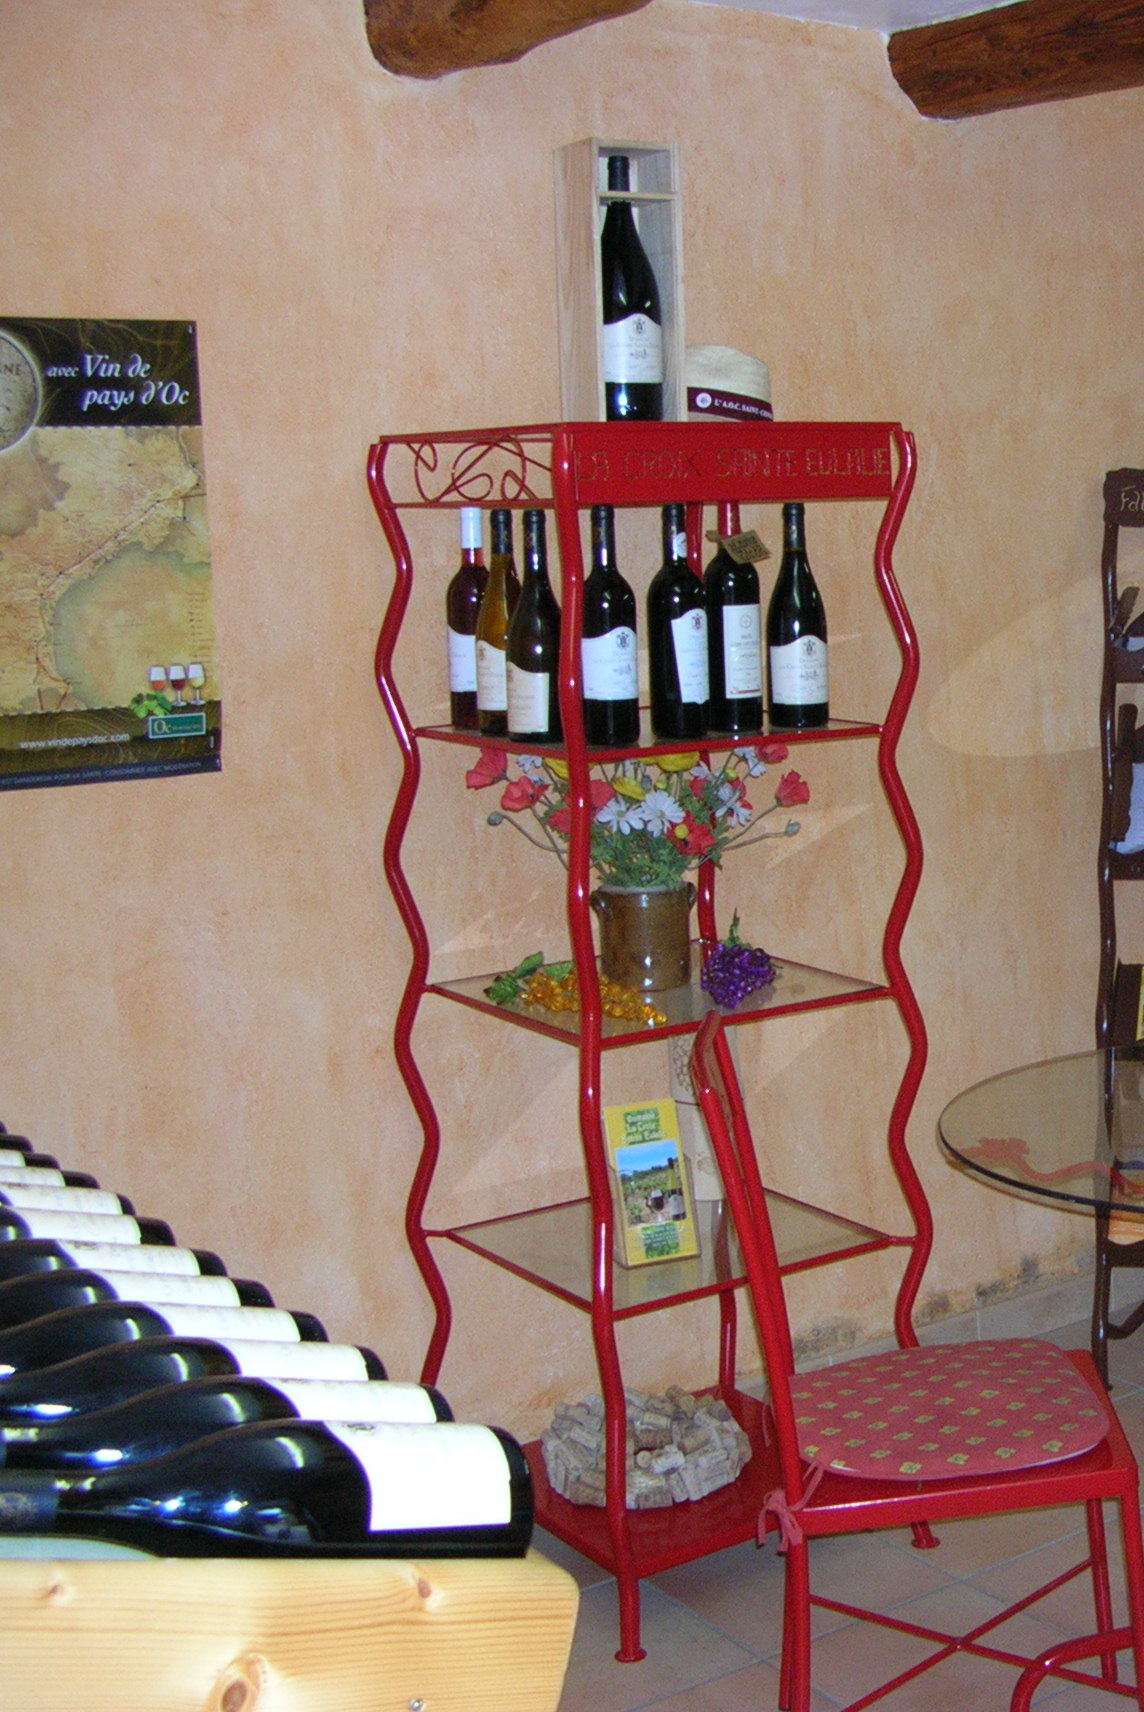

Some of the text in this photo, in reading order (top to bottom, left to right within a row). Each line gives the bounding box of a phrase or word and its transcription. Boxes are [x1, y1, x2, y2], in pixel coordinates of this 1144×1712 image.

[47, 353, 151, 377] avec Vin de
[81, 381, 189, 411] pays d'Oc
[19, 733, 130, 750] www.vindepaysdoc.com
